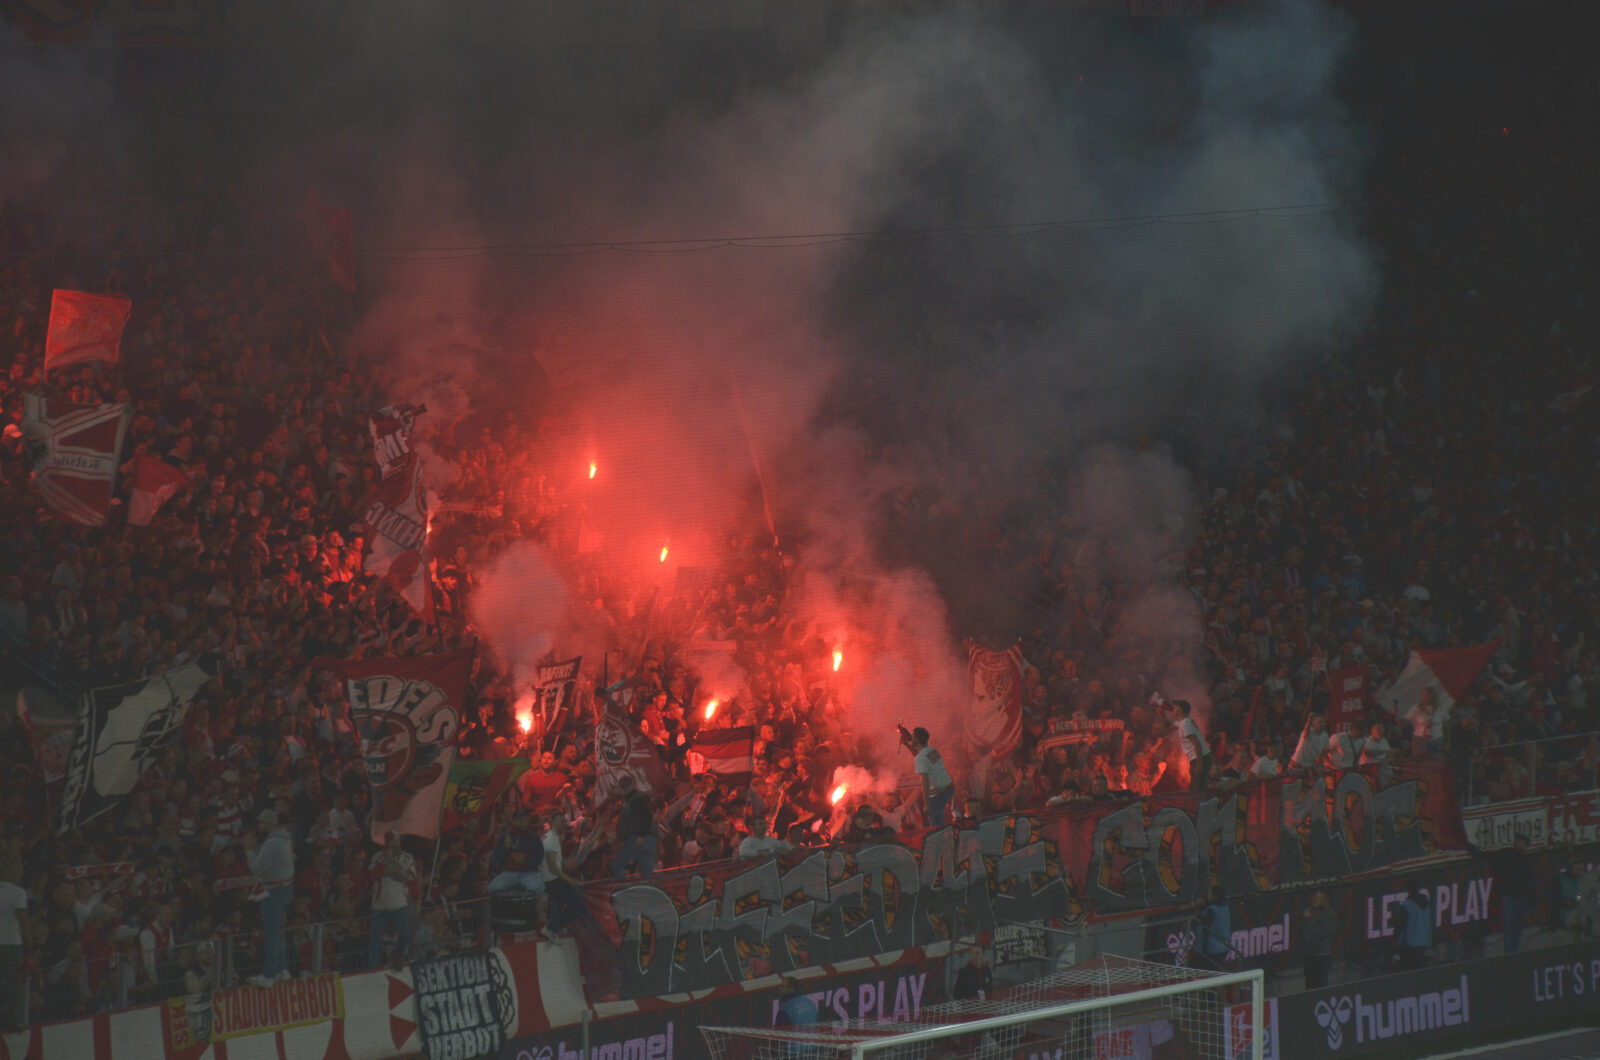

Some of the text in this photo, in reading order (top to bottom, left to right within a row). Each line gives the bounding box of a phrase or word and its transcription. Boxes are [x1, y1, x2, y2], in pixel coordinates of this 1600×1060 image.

[348, 675, 459, 744] EDELS
[1436, 878, 1493, 928] PLAY
[418, 956, 489, 995] SEKTION
[858, 973, 927, 1030] PLAY
[1533, 962, 1585, 1002] LET'S
[213, 974, 338, 1035] STADIONVERBOT
[420, 983, 497, 1036] STADT
[1354, 973, 1470, 1043] hummel
[427, 1022, 500, 1060] VERBOT
